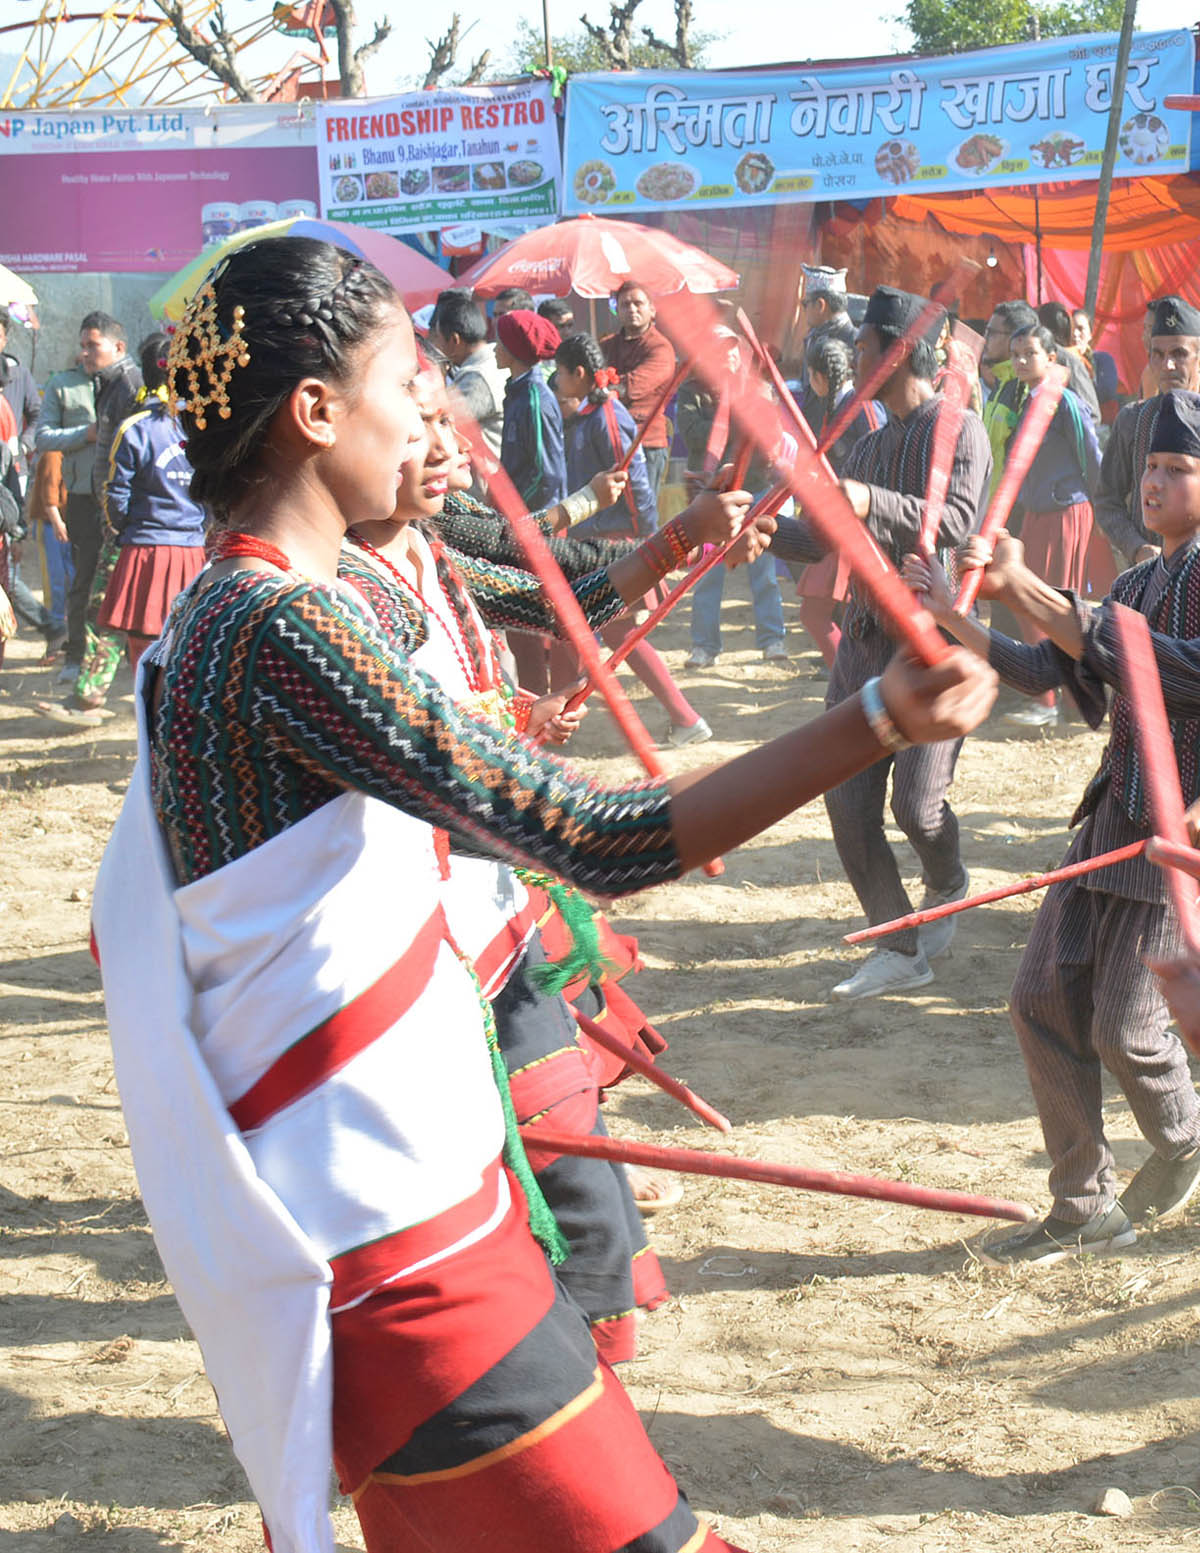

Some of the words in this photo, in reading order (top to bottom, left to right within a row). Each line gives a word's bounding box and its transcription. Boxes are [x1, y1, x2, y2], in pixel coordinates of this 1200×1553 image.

[601, 84, 777, 155] अस्मिता
[789, 69, 928, 137] नेवारी
[940, 66, 1072, 130] खाजा
[1084, 58, 1160, 114] घर
[31, 117, 97, 140] Japan
[102, 115, 142, 135] Pvt.
[149, 113, 190, 133] Ltd.
[325, 107, 454, 143] FRIENDSHIP
[459, 98, 546, 131] RESTRO
[362, 145, 395, 166] Bhanu
[190, 170, 230, 182] Technology
[22, 252, 64, 263] HARDWARE
[64, 251, 88, 263] PASAL
